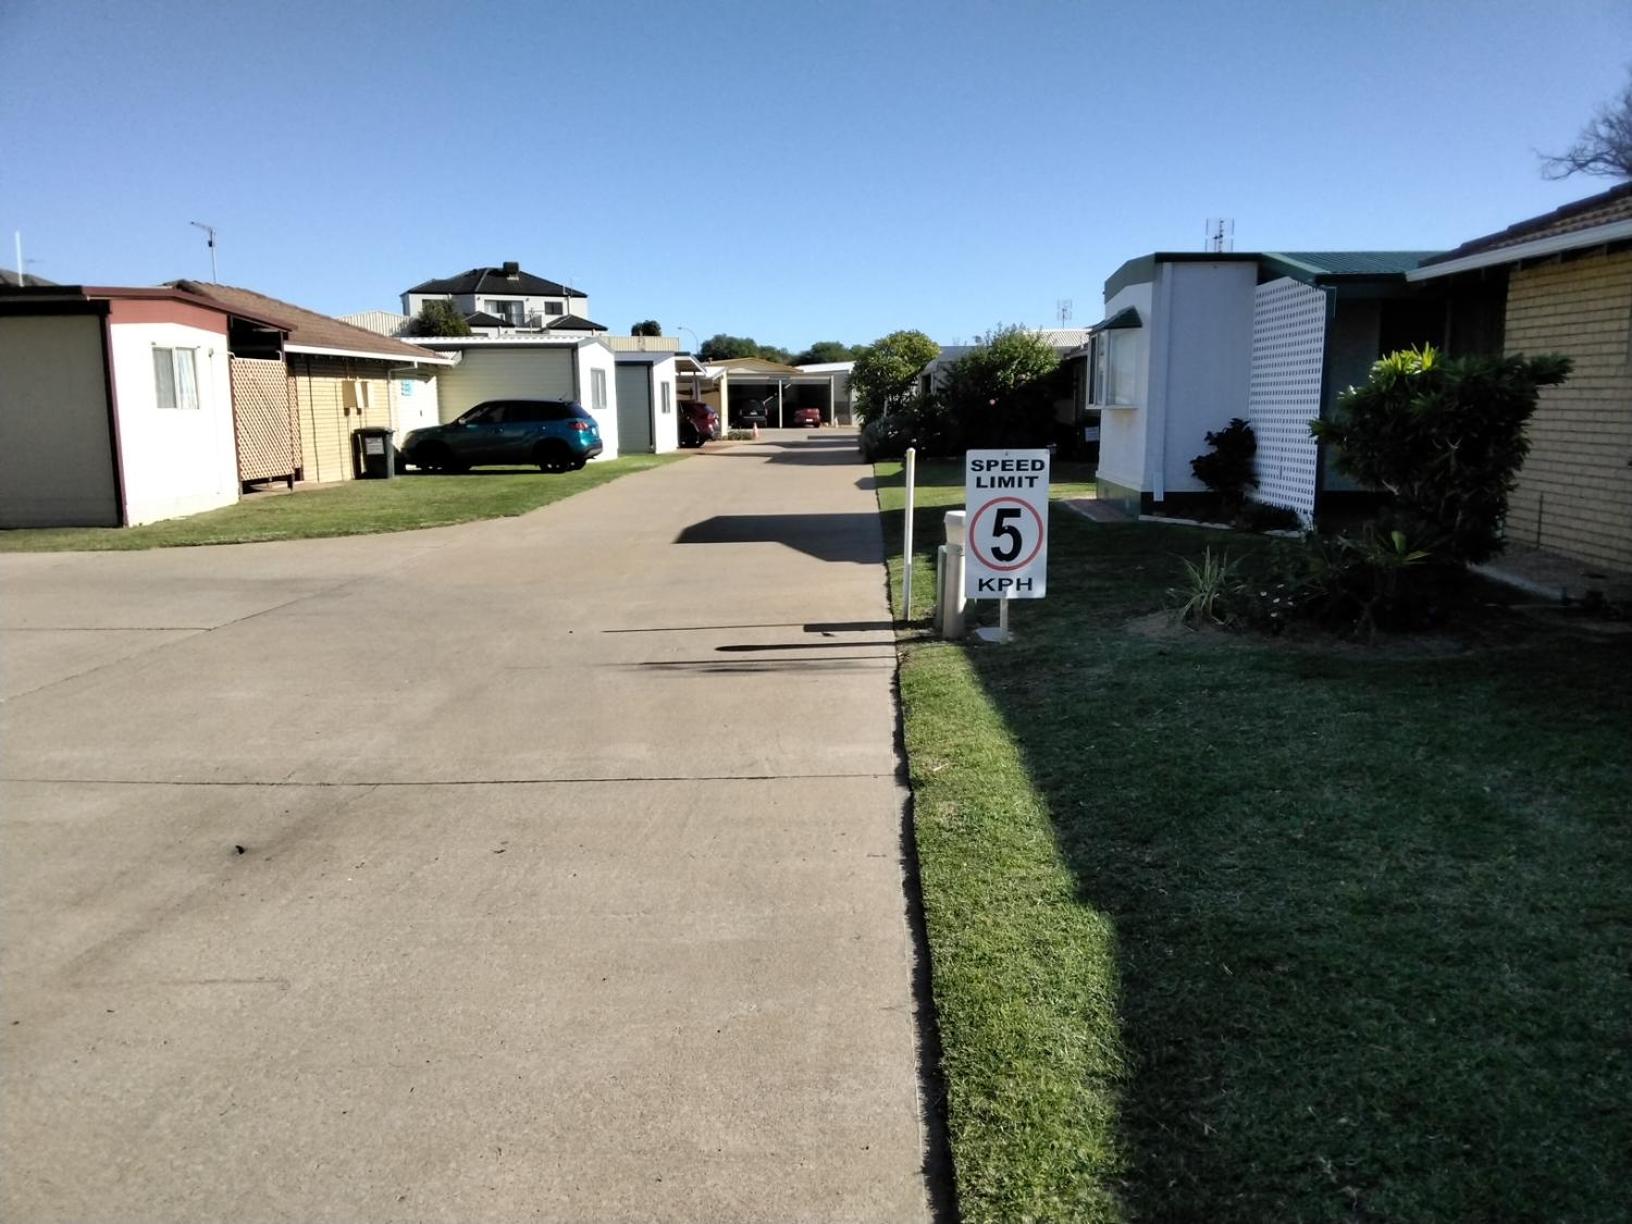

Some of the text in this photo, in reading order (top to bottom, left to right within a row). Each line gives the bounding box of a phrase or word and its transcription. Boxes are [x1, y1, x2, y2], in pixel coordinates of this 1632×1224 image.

[971, 459, 1045, 472] SPEED
[976, 476, 1039, 489] LIMIT
[990, 508, 1022, 562] 5
[978, 577, 1033, 592] KPH
